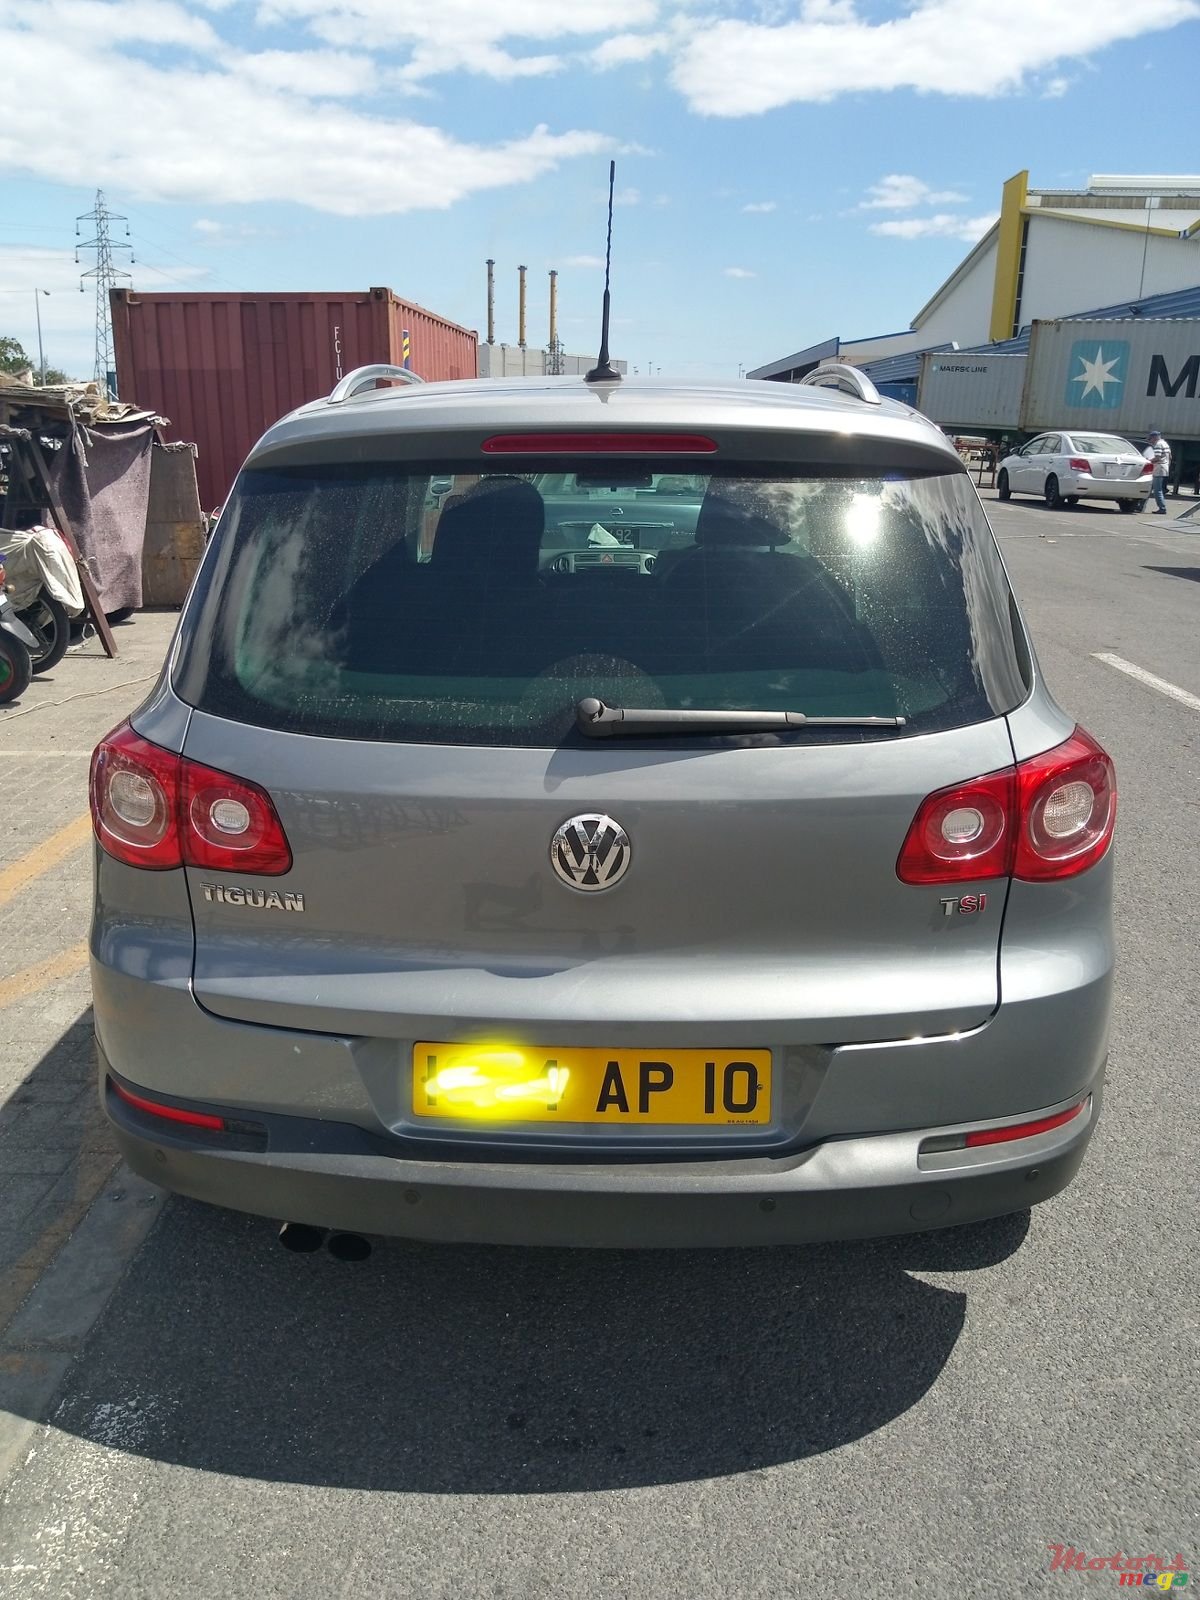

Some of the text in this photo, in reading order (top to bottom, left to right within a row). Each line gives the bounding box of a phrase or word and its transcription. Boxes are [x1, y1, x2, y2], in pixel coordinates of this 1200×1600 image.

[940, 365, 970, 373] MAERSK
[1146, 354, 1200, 399] M
[200, 883, 304, 912] TIGUAN
[940, 893, 987, 916] TSI
[595, 1061, 674, 1113] AP
